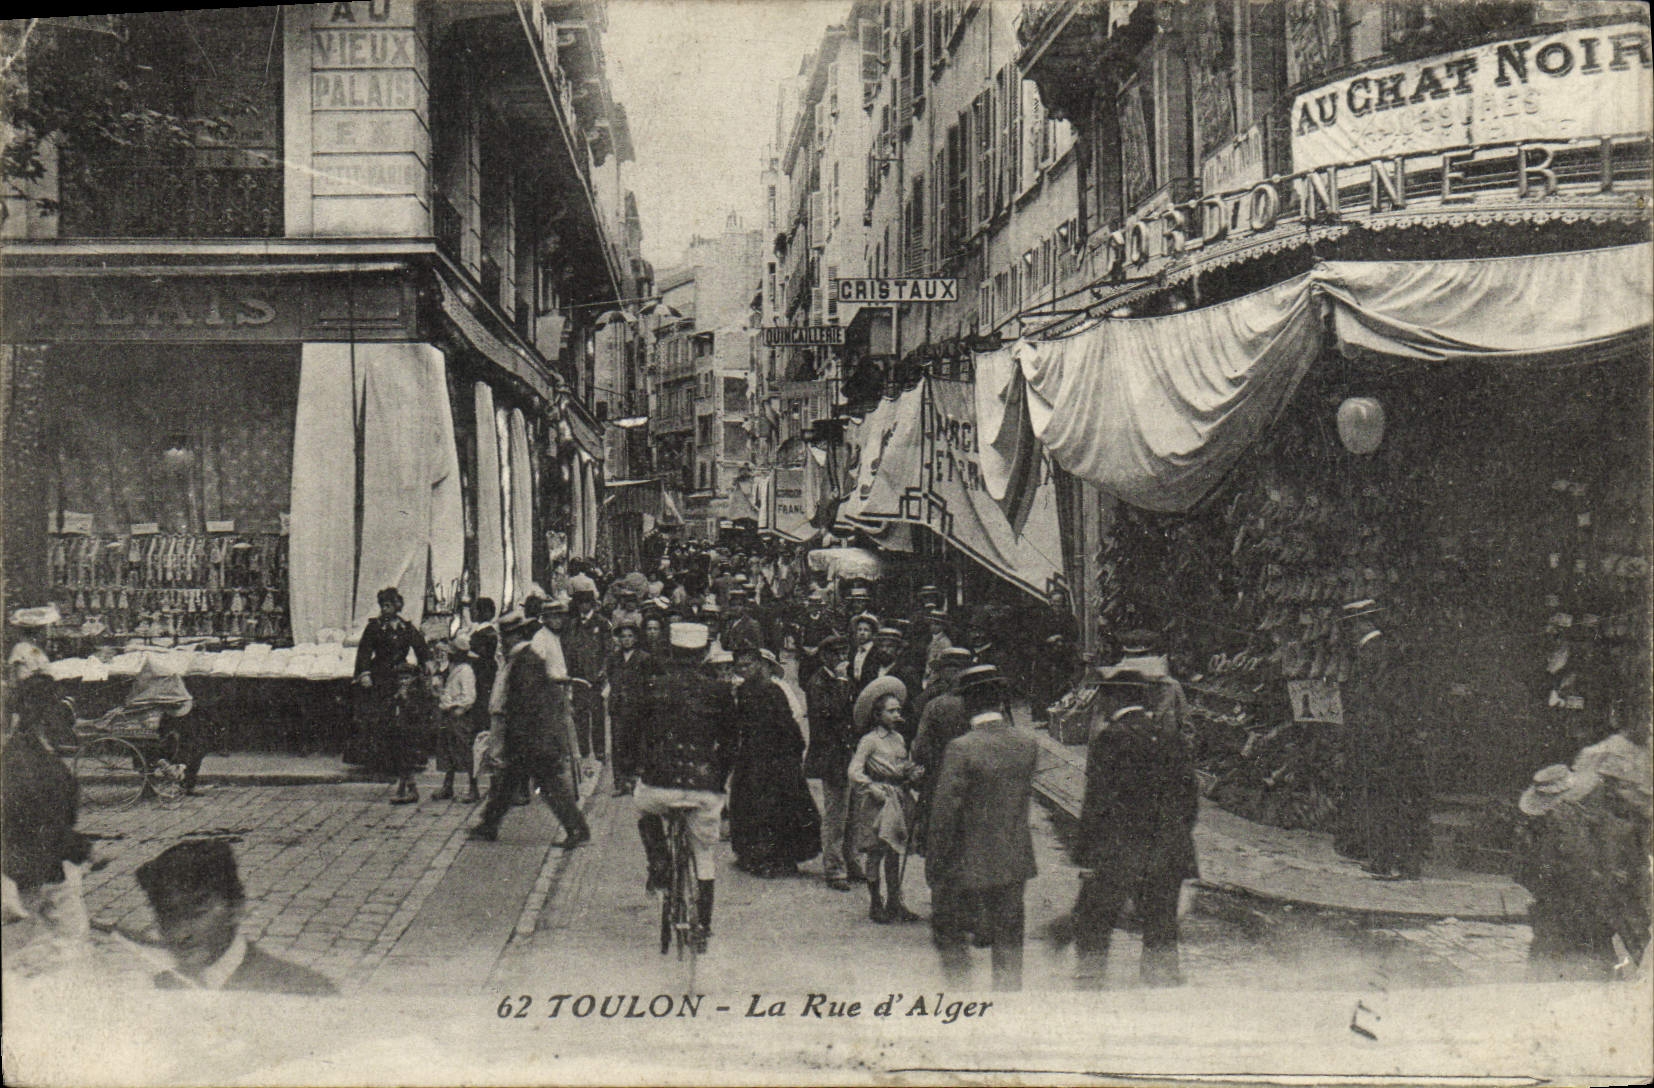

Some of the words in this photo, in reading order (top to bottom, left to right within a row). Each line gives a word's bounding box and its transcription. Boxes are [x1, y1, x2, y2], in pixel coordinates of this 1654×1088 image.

[330, 2, 390, 22] AU
[315, 31, 413, 65] VIEUX
[315, 74, 410, 107] PALAIS
[1296, 91, 1339, 137] AU
[1346, 55, 1478, 118] CHAT
[1494, 31, 1650, 88] NOIR
[841, 280, 954, 299] CRISTAUX
[766, 325, 842, 344] QUINCAILLERIE
